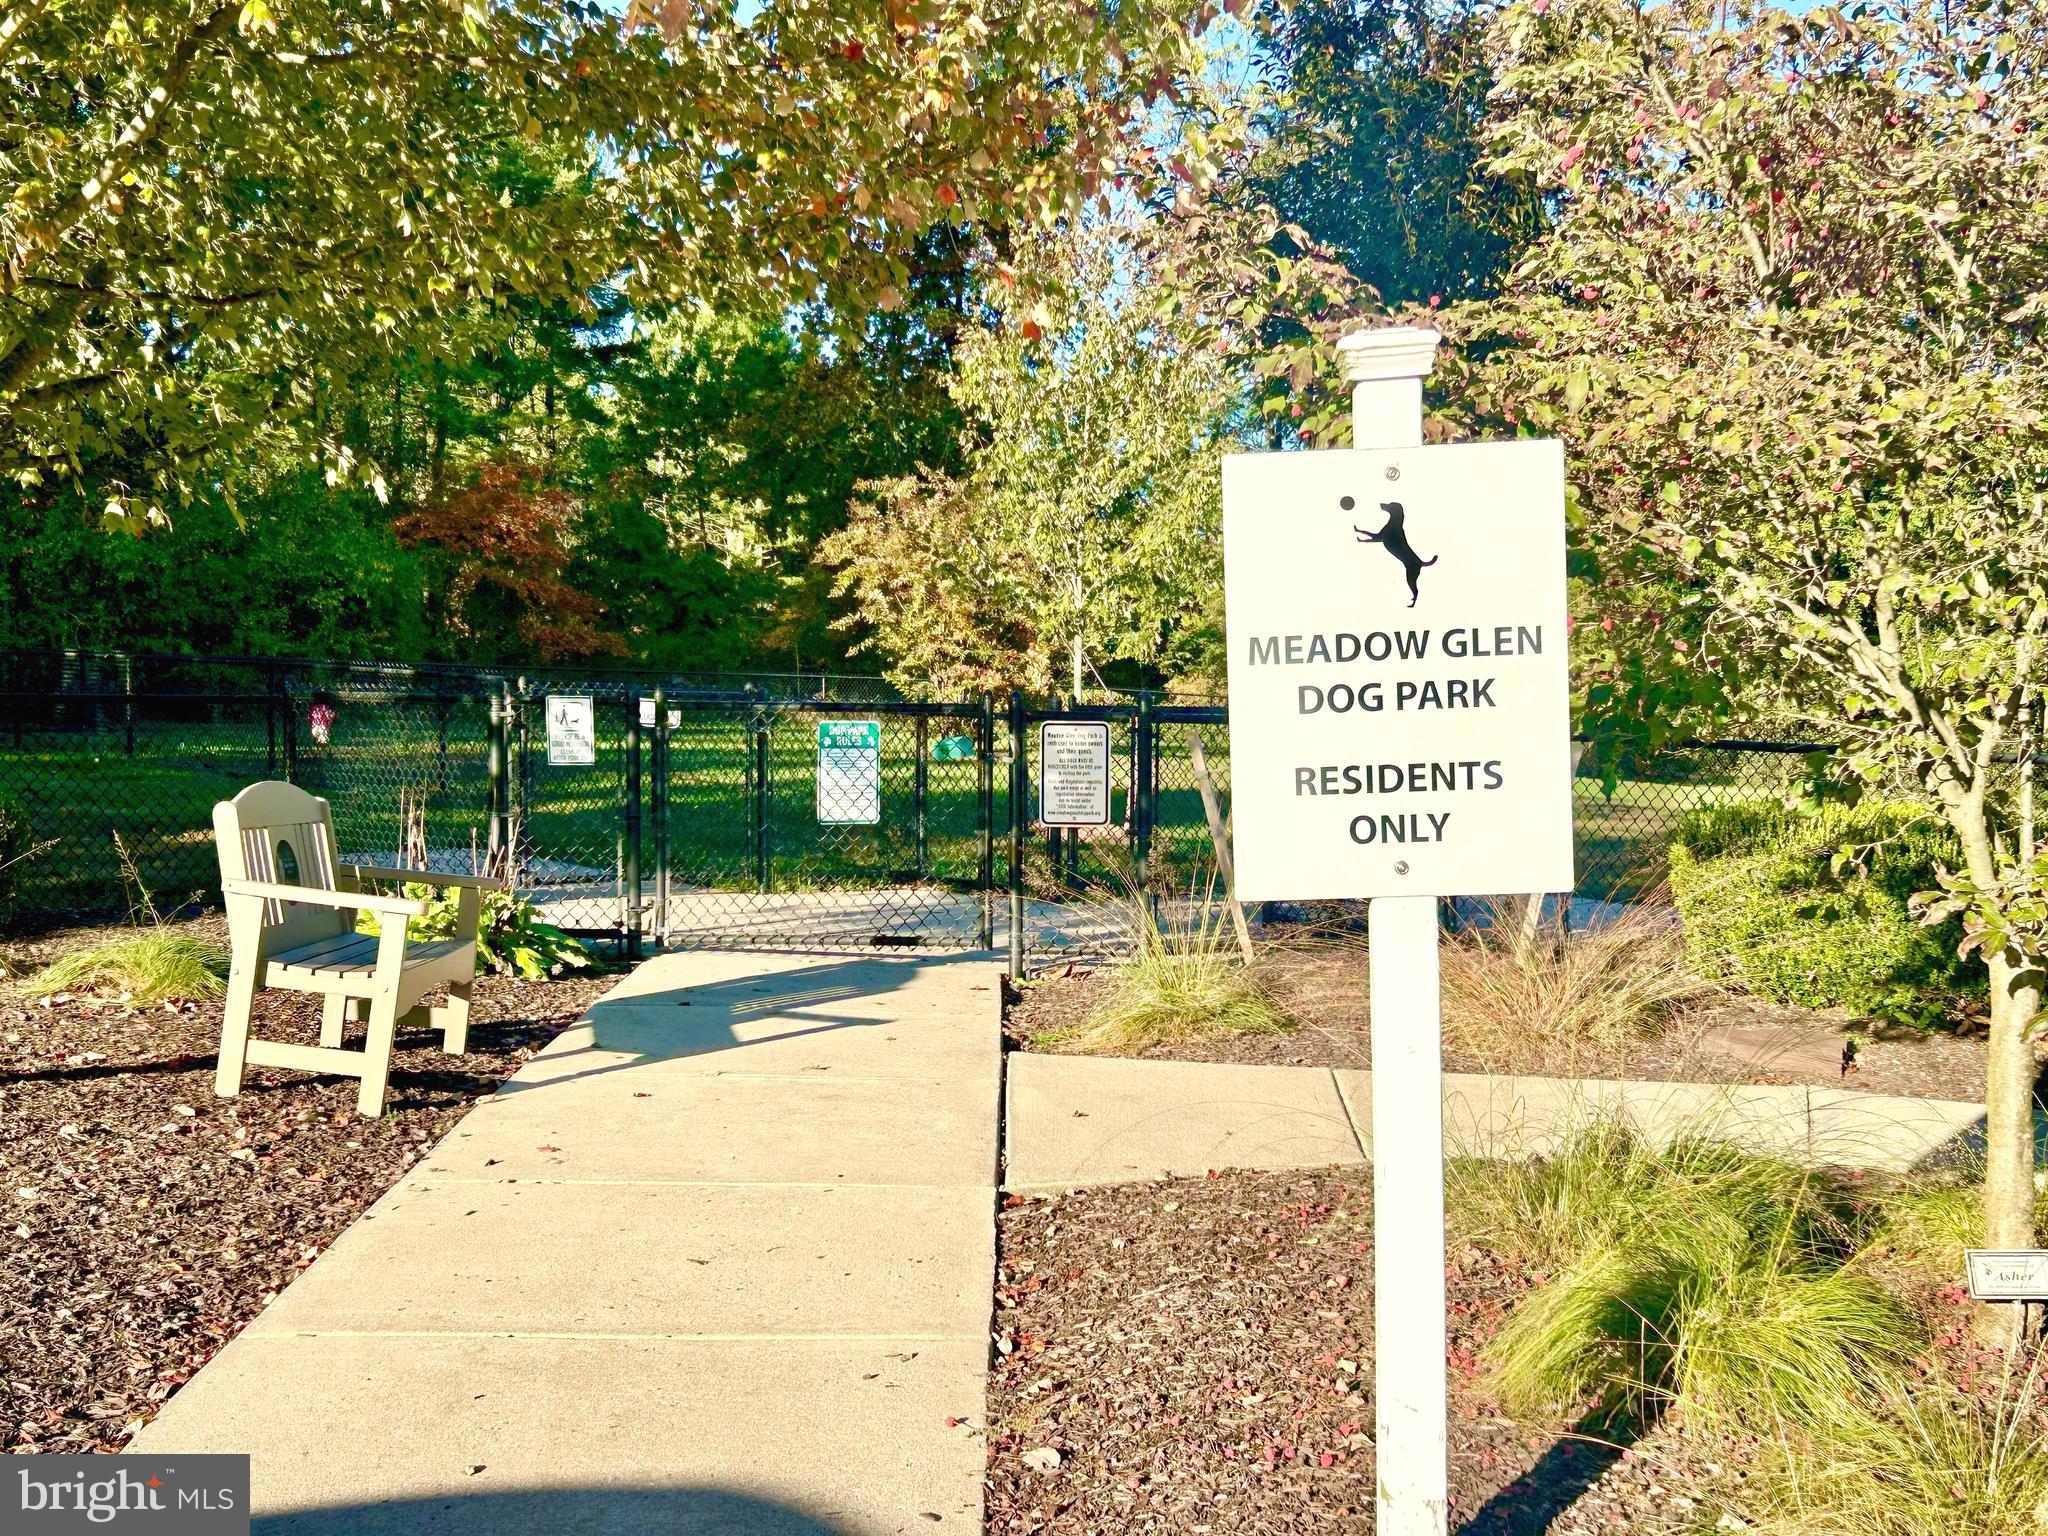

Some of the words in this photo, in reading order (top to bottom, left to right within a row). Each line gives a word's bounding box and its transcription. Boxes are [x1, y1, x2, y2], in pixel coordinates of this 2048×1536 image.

[1249, 630, 1430, 666] MEADOW
[1441, 625, 1542, 657] GLEN
[1298, 682, 1384, 714] DOG
[1396, 678, 1497, 710] PARK
[836, 736, 862, 746] RULES
[1295, 760, 1504, 796] RESIDENTS
[1349, 812, 1451, 845] ONLY
[1995, 1272, 2034, 1283] Asher
